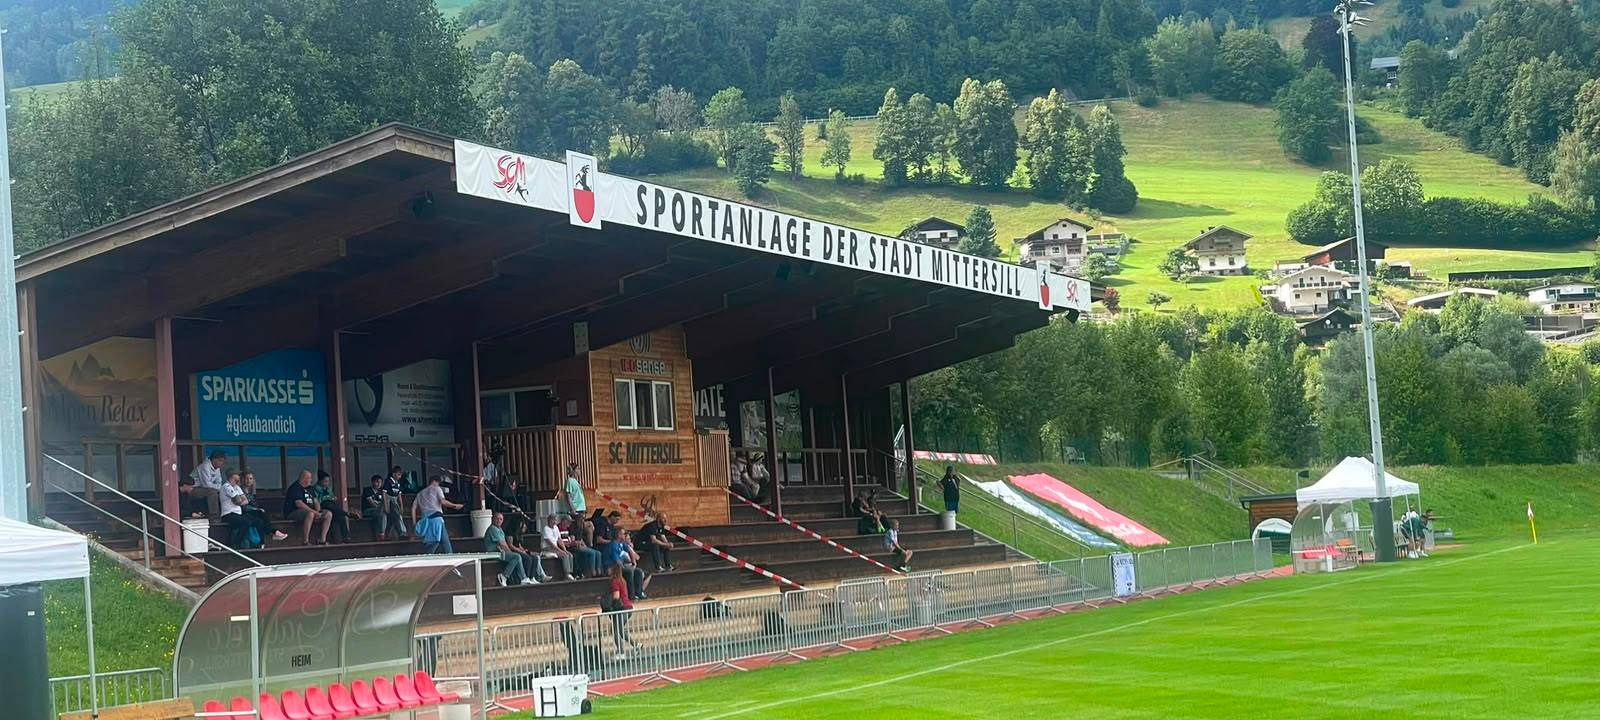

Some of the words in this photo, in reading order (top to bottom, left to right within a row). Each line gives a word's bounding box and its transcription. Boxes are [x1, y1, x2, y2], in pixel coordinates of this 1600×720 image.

[636, 184, 811, 257] SPORTANLAGE
[823, 225, 859, 267] DER
[869, 235, 923, 278] STADT
[931, 249, 1022, 297] MITTERSILL
[201, 375, 297, 404] SPARKASSE
[102, 394, 149, 424] Relax
[226, 413, 296, 437] #glaubandich
[608, 441, 624, 465] SC
[626, 441, 683, 465] MITTERSILL
[291, 654, 312, 669] HEIM
